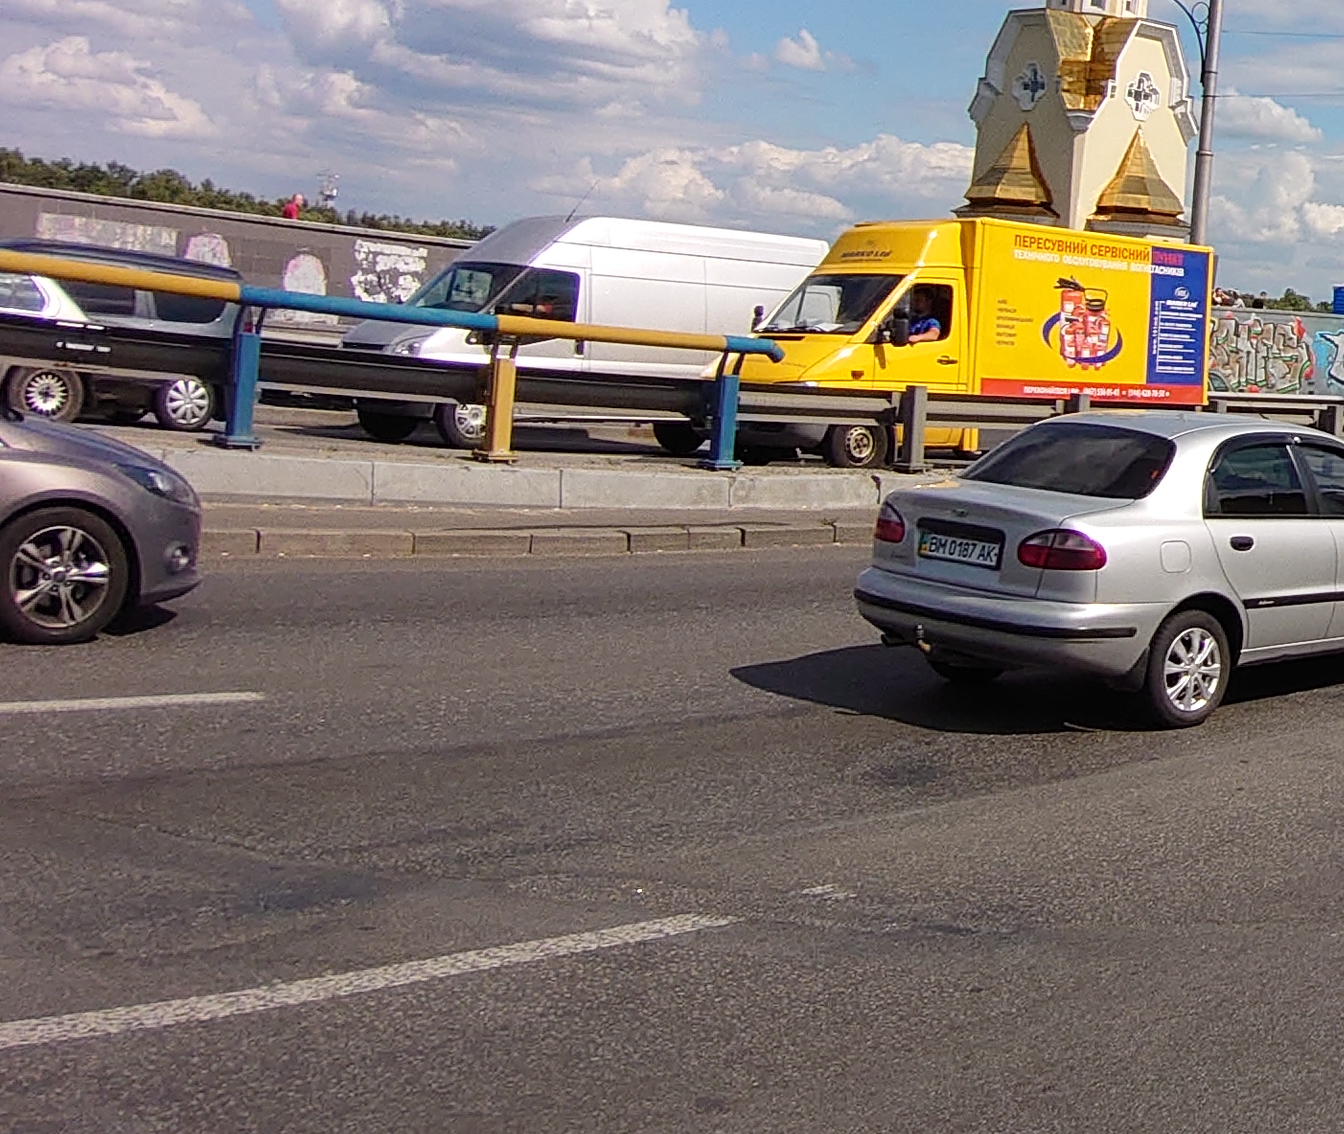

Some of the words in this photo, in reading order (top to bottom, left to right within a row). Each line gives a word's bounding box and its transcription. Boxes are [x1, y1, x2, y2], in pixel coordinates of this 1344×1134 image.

[1014, 234, 1087, 255] ПЕРЕСУВНИЙ
[1090, 243, 1150, 261] СЕРВІСНИЙ
[929, 536, 947, 556] BM
[949, 541, 976, 560] 0187
[978, 545, 995, 562] AK
